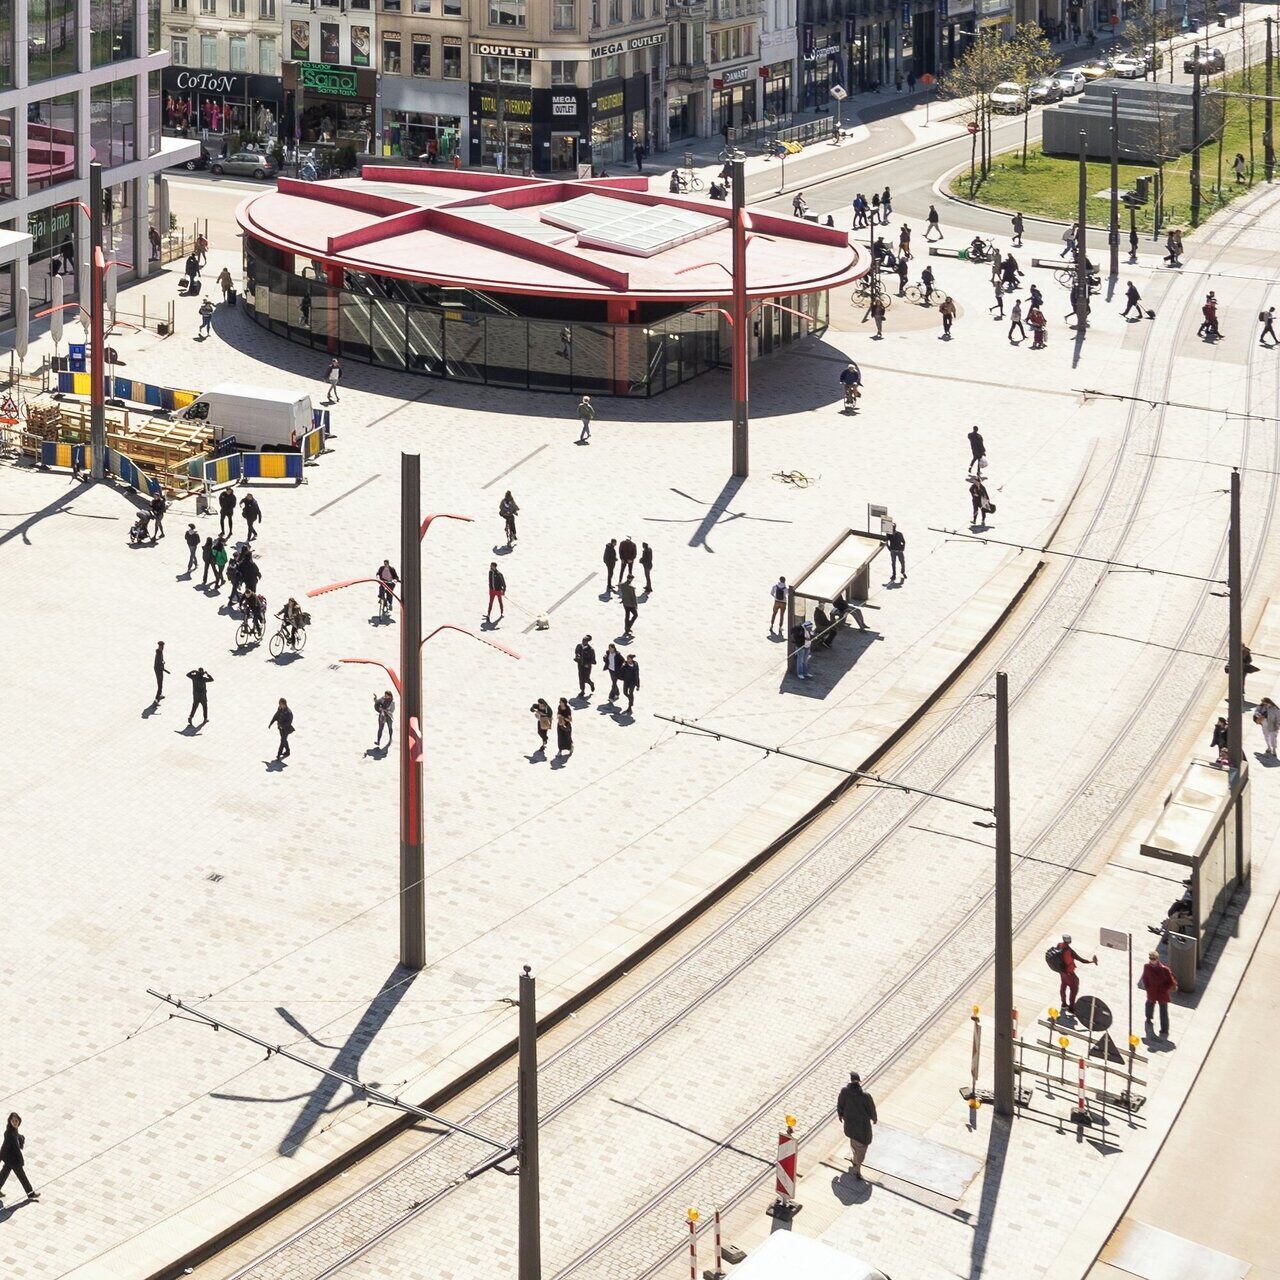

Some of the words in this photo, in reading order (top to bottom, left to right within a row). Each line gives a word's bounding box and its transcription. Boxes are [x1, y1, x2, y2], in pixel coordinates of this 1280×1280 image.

[632, 34, 663, 48] OUTLET
[480, 45, 532, 57] OUTLET
[592, 43, 624, 58] MEGA
[305, 70, 352, 89] Sano
[555, 105, 574, 114] OUTLET
